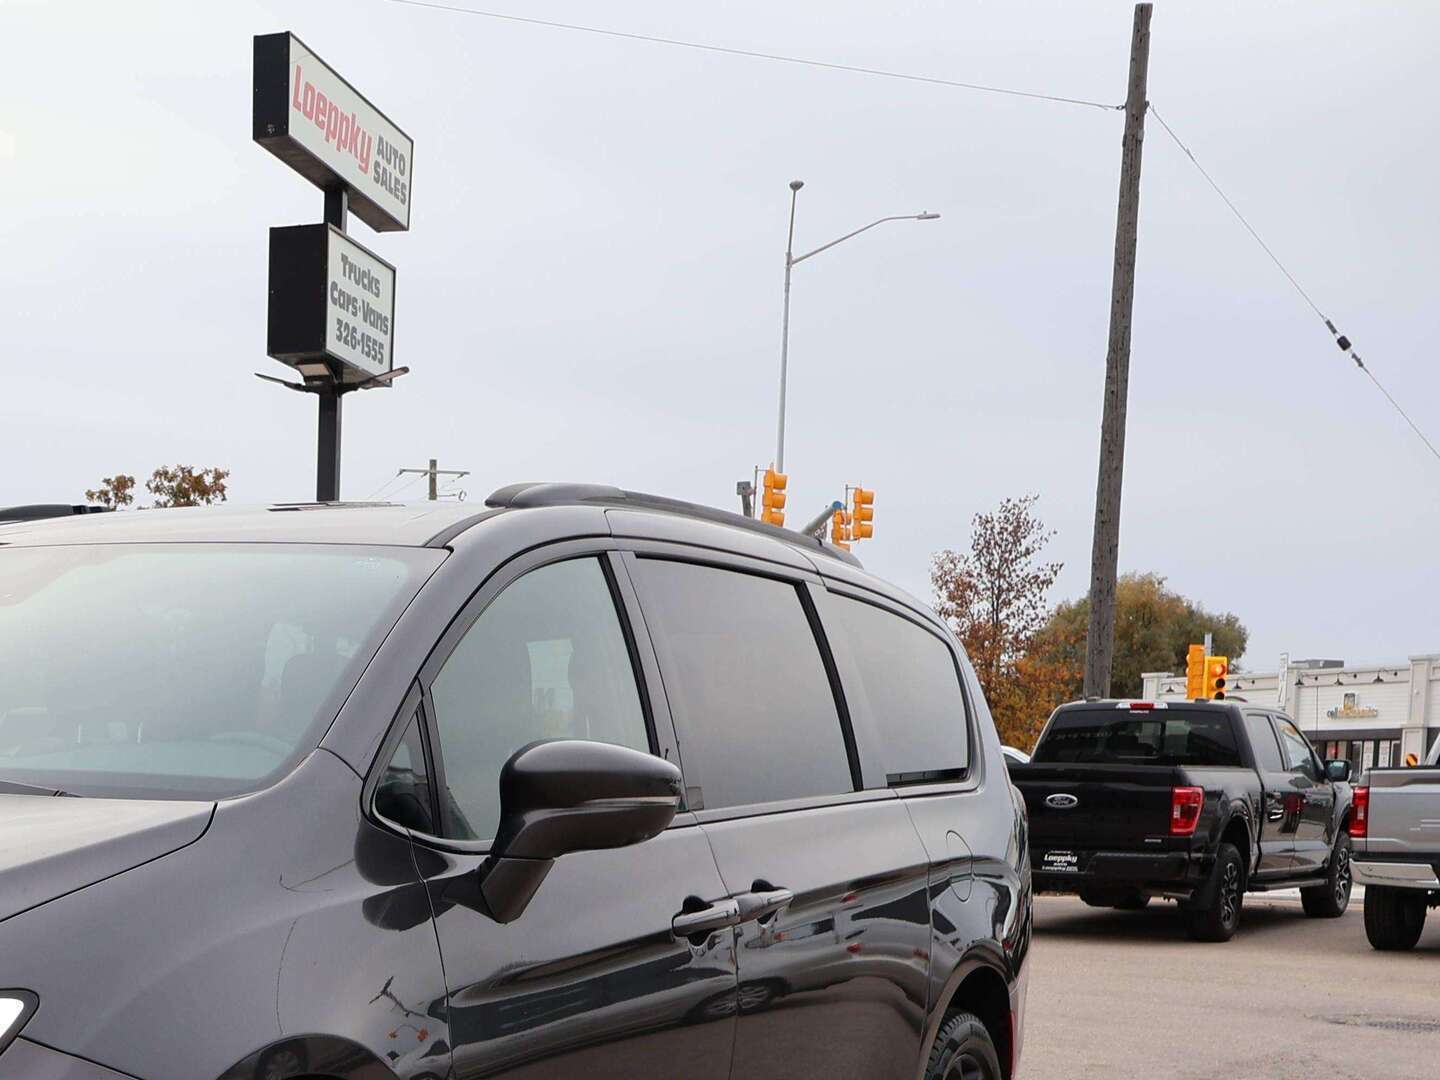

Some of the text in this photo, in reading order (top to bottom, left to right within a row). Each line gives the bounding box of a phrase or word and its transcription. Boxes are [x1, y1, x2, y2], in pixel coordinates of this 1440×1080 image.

[292, 64, 372, 174] Loeppky
[376, 135, 406, 177] AUTO
[373, 159, 407, 205] SALES
[341, 252, 380, 298] Trucks
[336, 318, 384, 365] 326-1555
